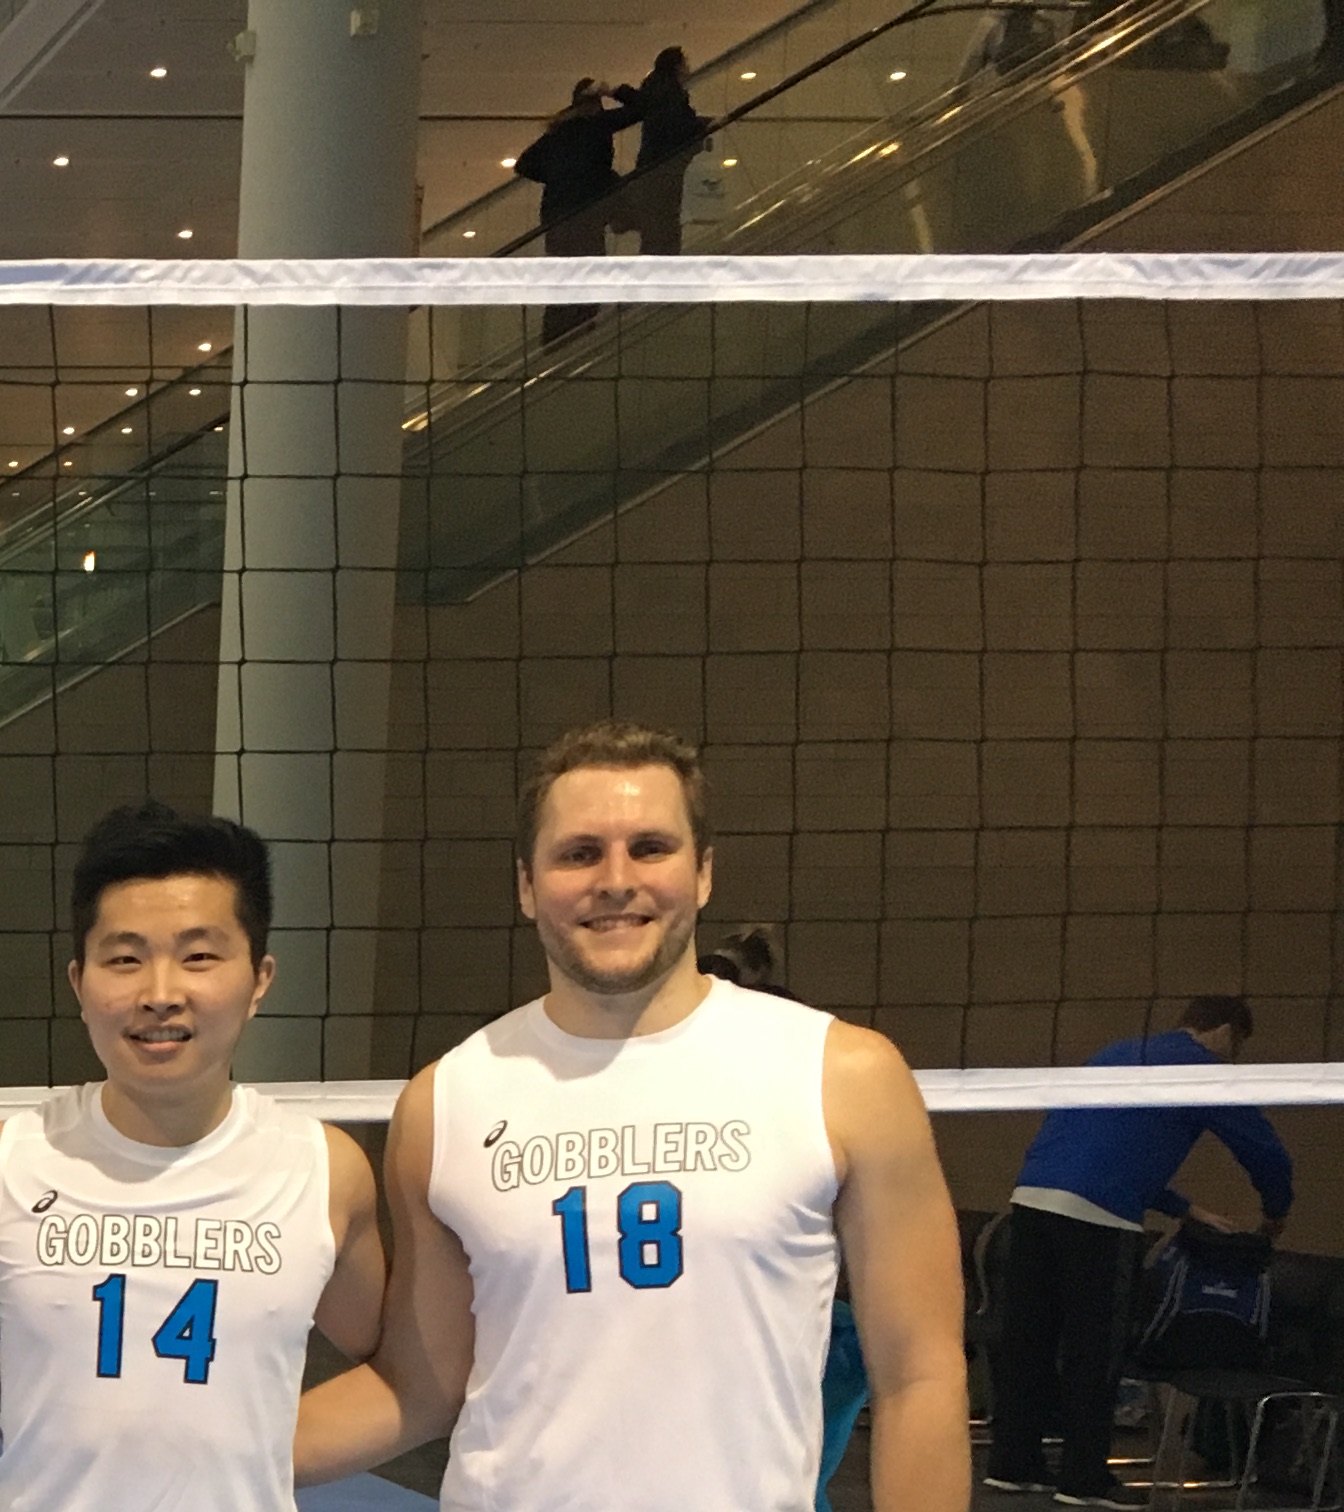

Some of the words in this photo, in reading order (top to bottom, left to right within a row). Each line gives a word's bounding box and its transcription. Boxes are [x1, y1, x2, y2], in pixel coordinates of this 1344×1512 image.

[490, 1119, 752, 1193] GOBBLERS
[36, 1213, 283, 1275] GOBBLERS
[552, 1180, 684, 1294] 18
[91, 1272, 220, 1385] 14
